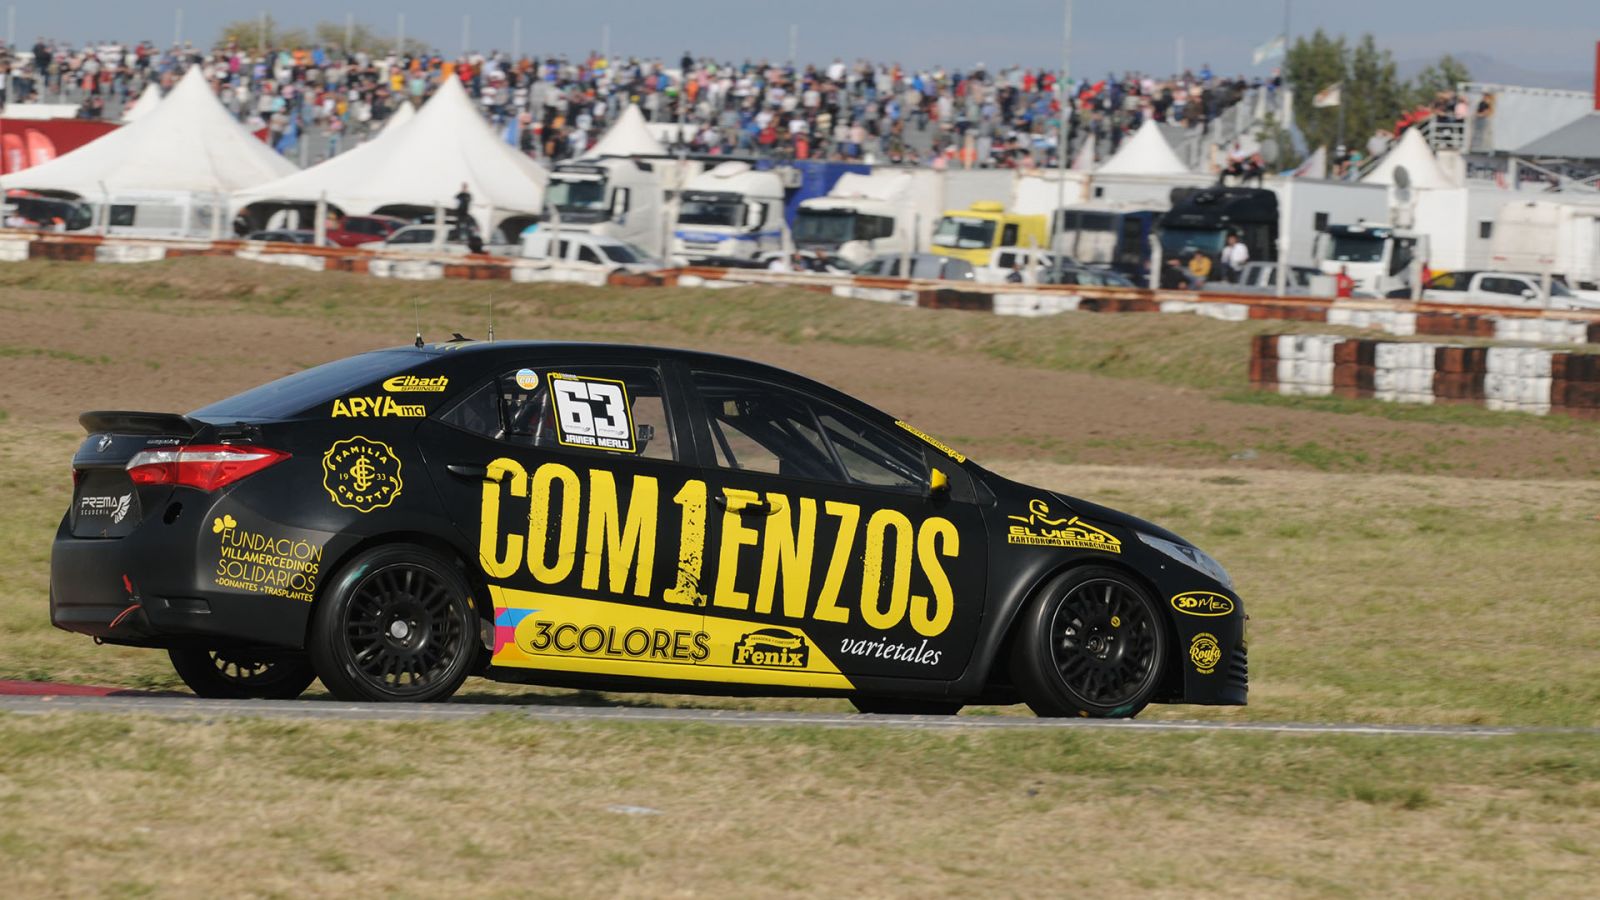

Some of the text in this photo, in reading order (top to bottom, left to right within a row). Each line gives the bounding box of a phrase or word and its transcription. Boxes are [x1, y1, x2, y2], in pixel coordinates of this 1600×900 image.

[382, 375, 449, 392] Eibach
[554, 379, 629, 439] 63
[565, 434, 630, 449] JAVIER MERLO
[335, 446, 388, 464] FAMILIA
[339, 472, 386, 481] 19 33
[81, 496, 118, 508] PREMA
[338, 484, 390, 503] CROTTA
[1009, 525, 1106, 543] EL VIEJO
[1010, 535, 1119, 552] KARTODROMO INTERNACIONAL
[221, 528, 323, 562] FUNDACIÓN
[220, 545, 319, 574] VILLAMERCEDINOS
[216, 559, 316, 592] SOLIDARIOS
[215, 577, 313, 602] +DONANTES +TRASPLANTES
[1178, 597, 1198, 608] 3D
[530, 620, 711, 662] 3COLORES
[840, 636, 942, 665] varietales
[735, 645, 804, 667] Fenix
